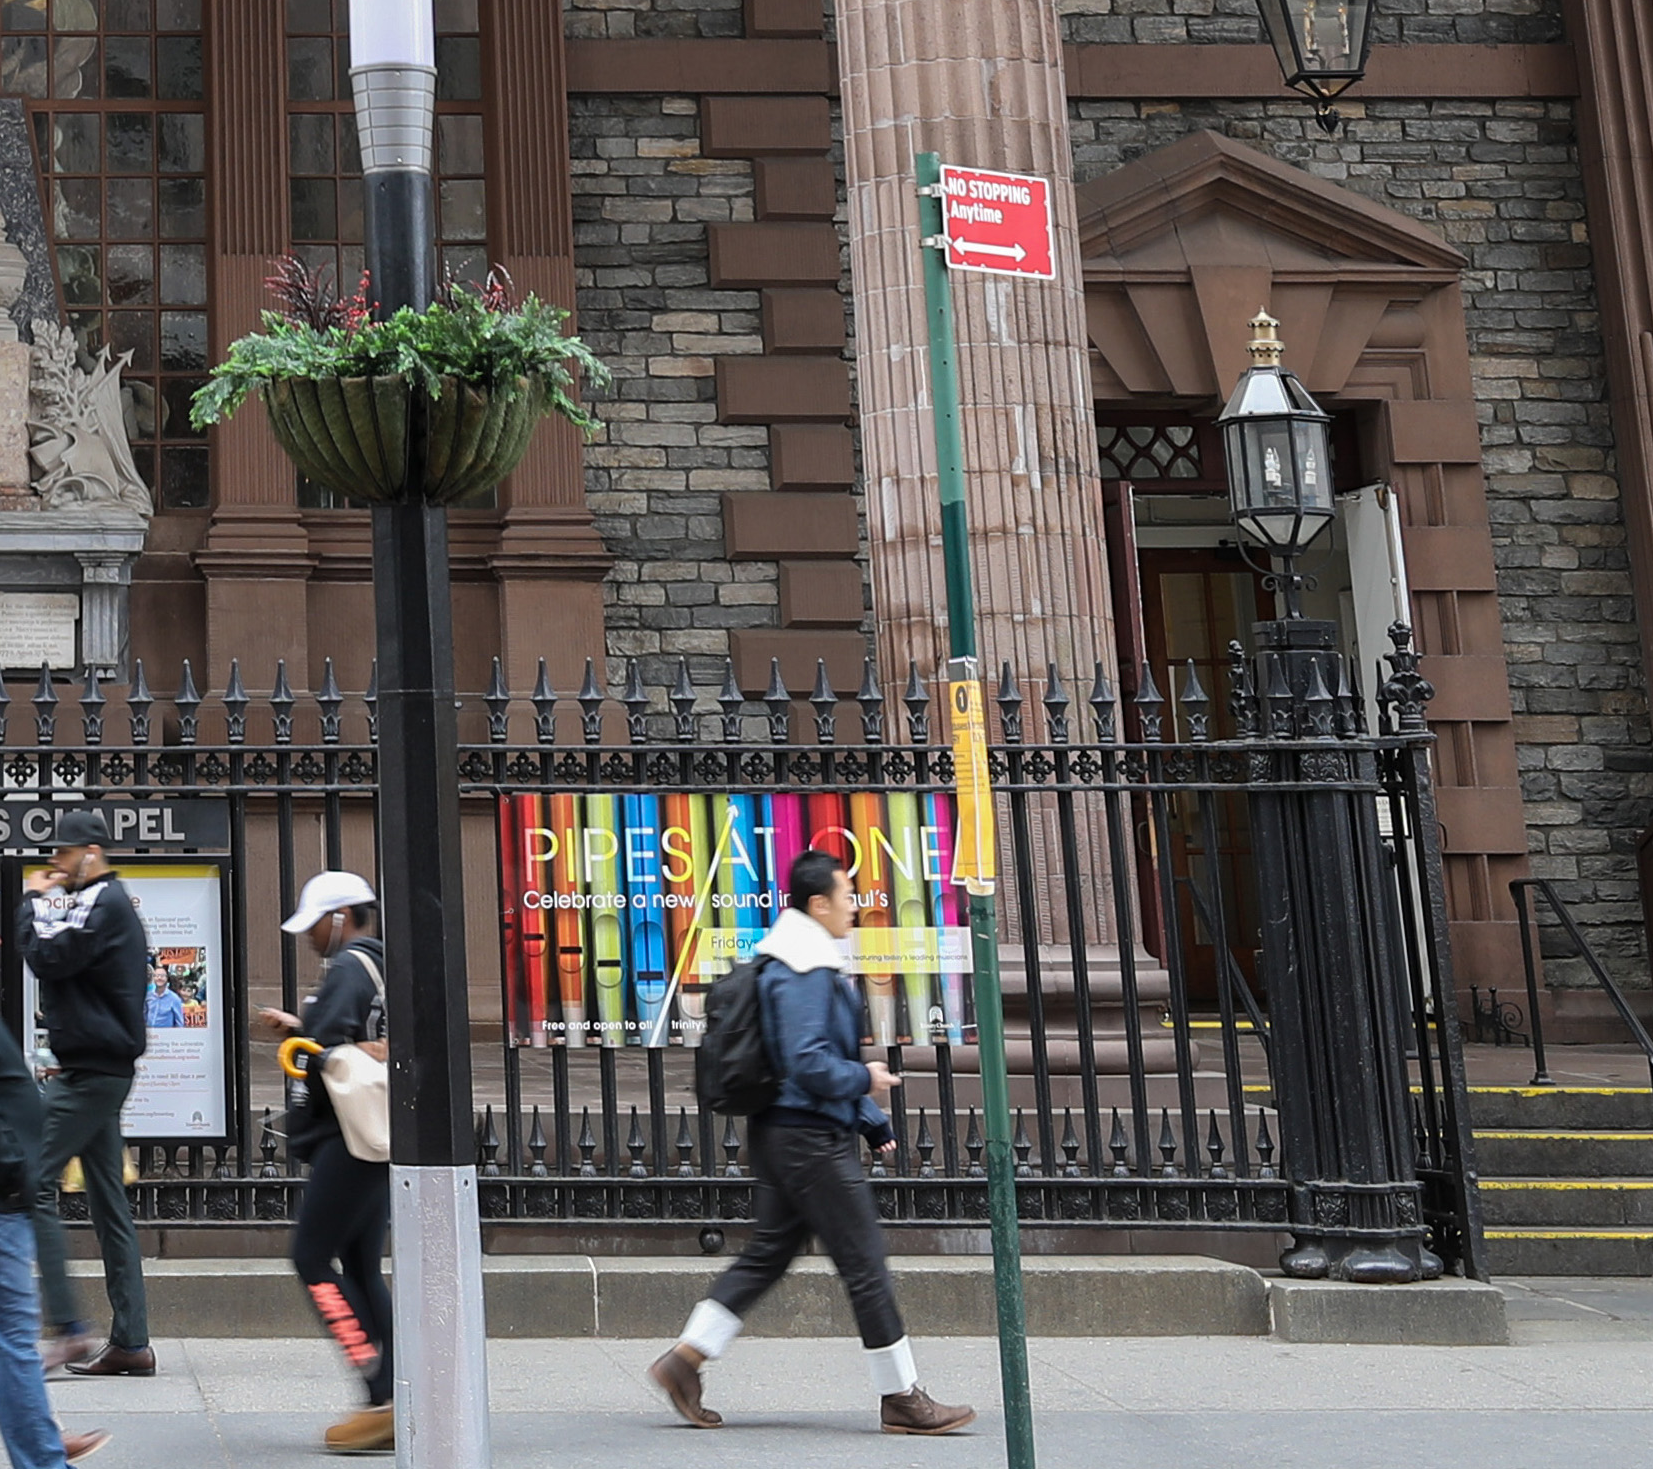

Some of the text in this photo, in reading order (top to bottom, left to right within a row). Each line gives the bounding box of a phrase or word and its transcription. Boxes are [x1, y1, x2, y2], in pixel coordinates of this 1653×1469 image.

[948, 177, 1031, 205] NO STOPPING
[951, 200, 1002, 224] Anytime
[524, 826, 950, 883] PIPES AT ONE
[524, 890, 772, 910] Celebrate a new sound
[542, 1021, 707, 1032] Free and open to all trinity
